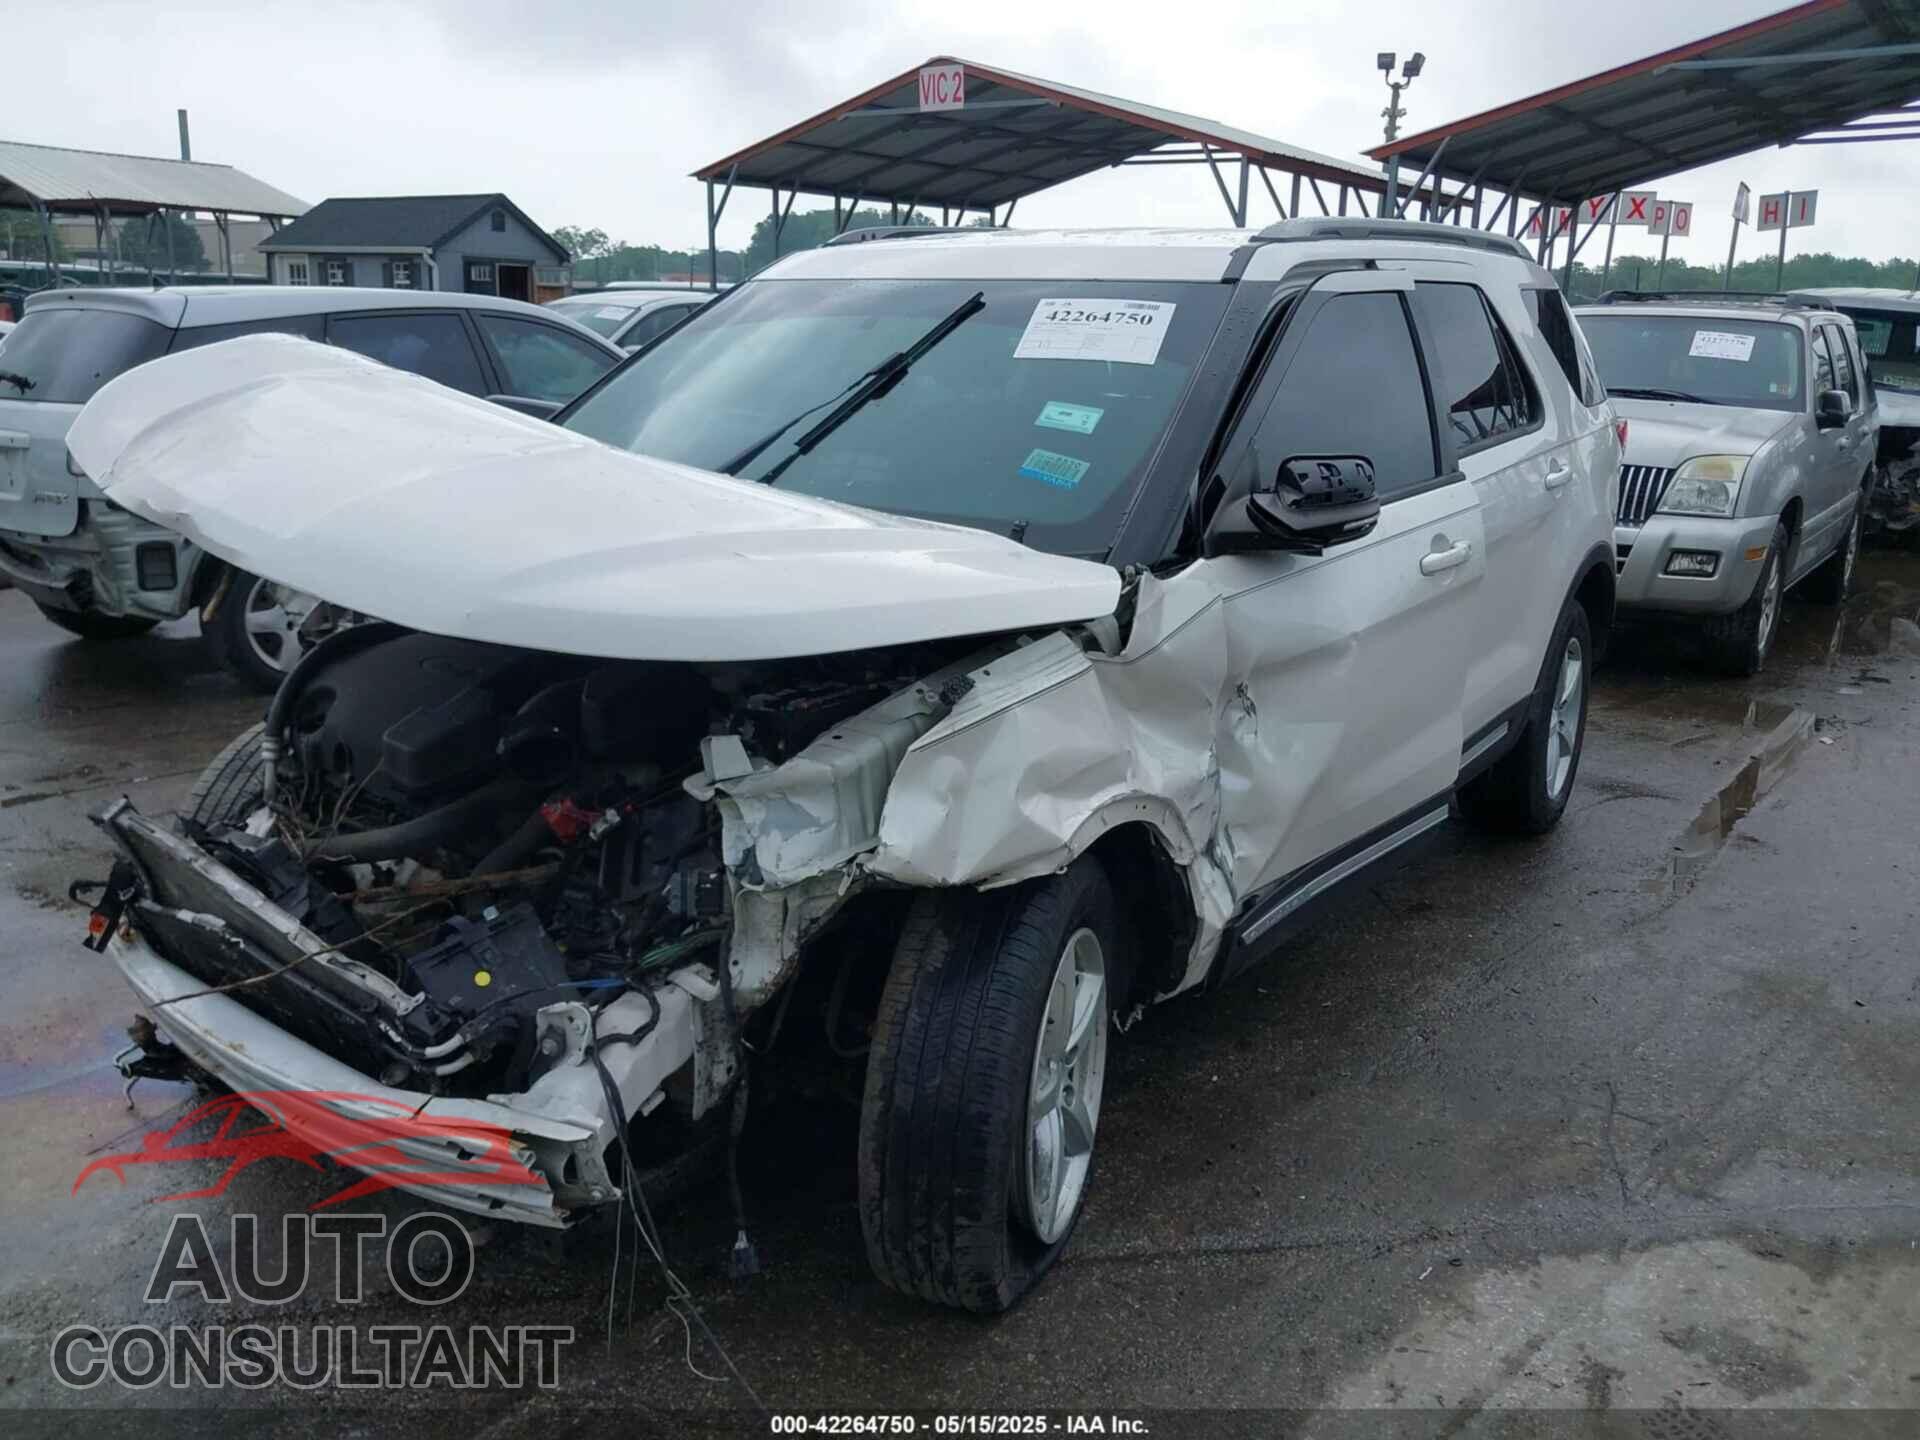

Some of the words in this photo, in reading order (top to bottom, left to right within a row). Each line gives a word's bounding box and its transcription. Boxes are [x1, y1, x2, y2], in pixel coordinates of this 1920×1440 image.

[920, 72, 948, 105] VIC
[952, 71, 962, 104] 2
[1588, 197, 1605, 218] Y
[1627, 197, 1647, 219] X
[1654, 207, 1665, 225] P
[1764, 200, 1779, 225] H
[1045, 309, 1153, 326] 42264750
